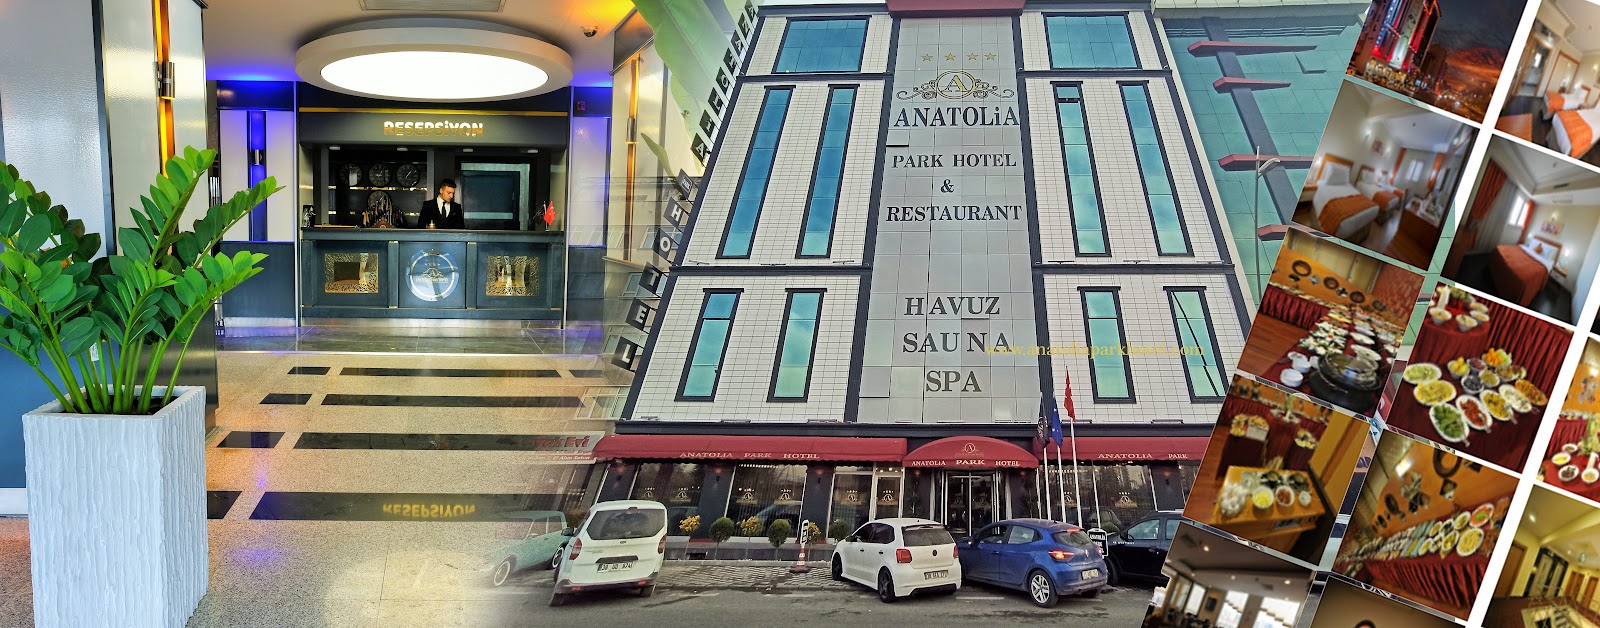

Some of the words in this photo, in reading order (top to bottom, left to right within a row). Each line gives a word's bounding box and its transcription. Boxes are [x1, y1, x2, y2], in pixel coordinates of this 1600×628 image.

[891, 154, 944, 168] PARK
[952, 153, 1017, 168] HOTEL
[940, 178, 955, 193] &
[885, 205, 1022, 222] RESTAURANT
[903, 296, 1001, 316] HAVUZ
[902, 332, 1013, 353] SAUNA
[925, 370, 982, 392] SPA
